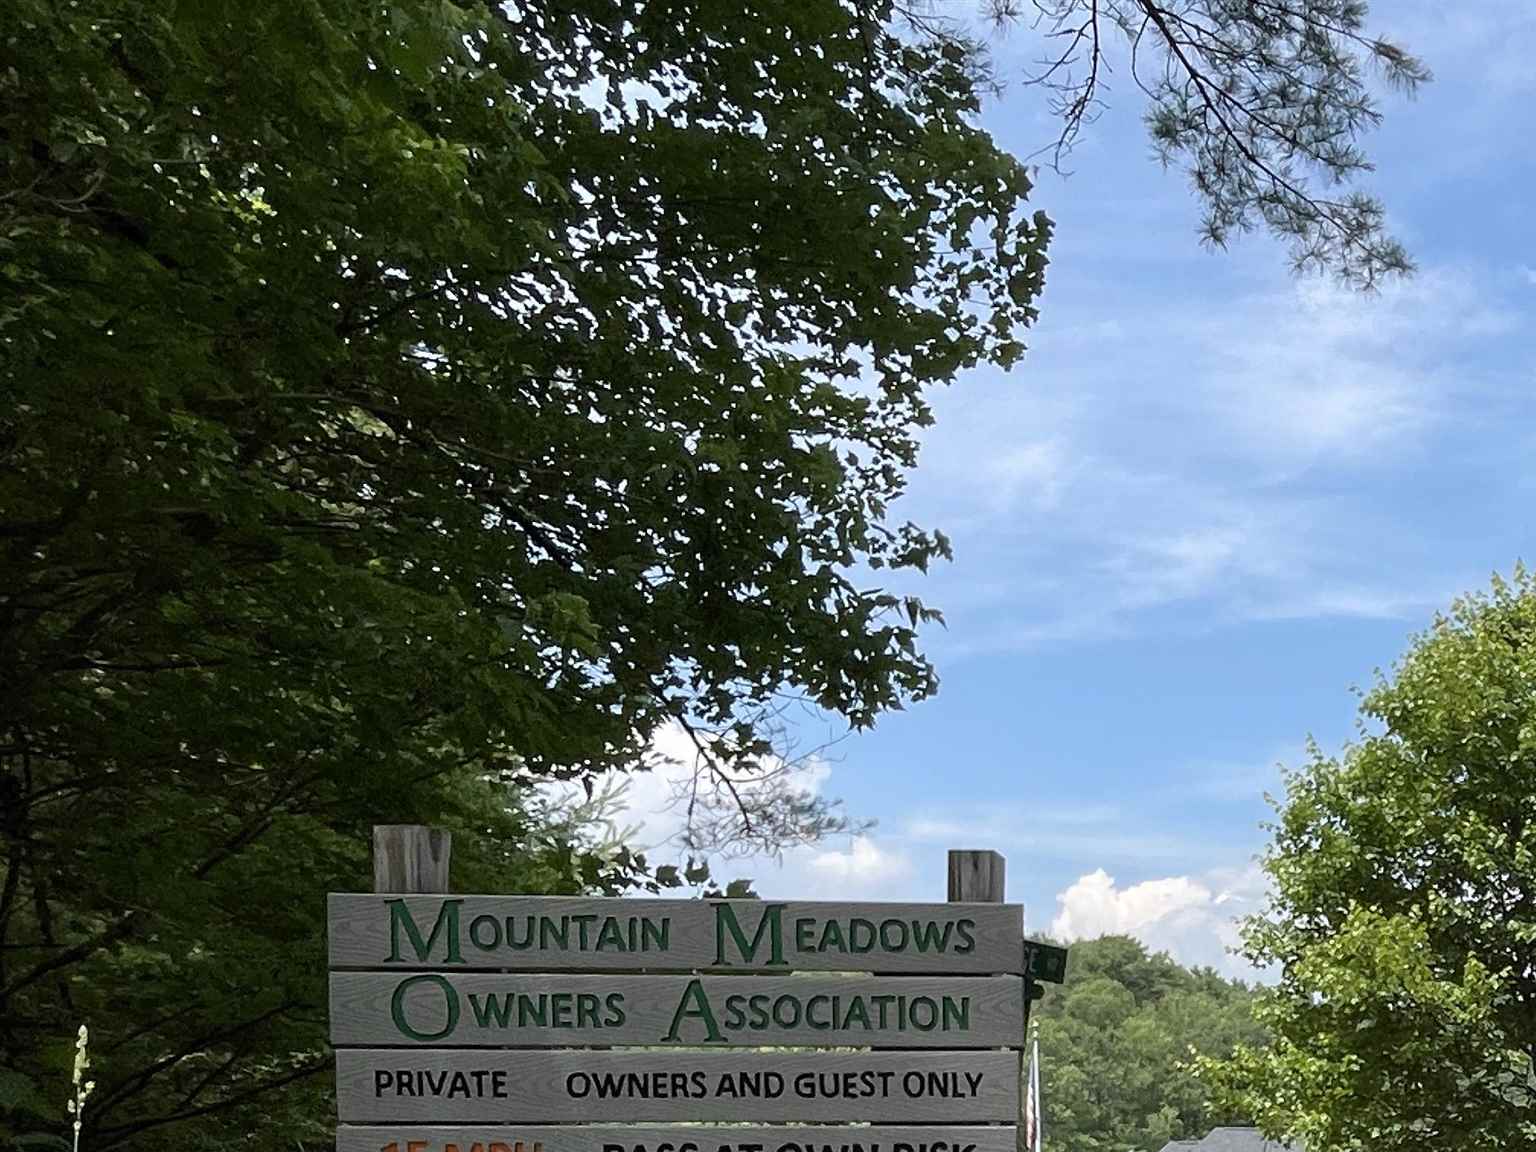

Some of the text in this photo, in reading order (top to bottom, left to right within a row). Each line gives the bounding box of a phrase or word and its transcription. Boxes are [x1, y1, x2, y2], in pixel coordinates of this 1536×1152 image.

[383, 898, 671, 964] MOUNTAIN
[709, 901, 976, 967] MEADOWS
[391, 974, 970, 1042] OWNERS ASSOCIATION
[374, 1069, 983, 1099] PRIVATE OWNERS AND GUEST ONLY
